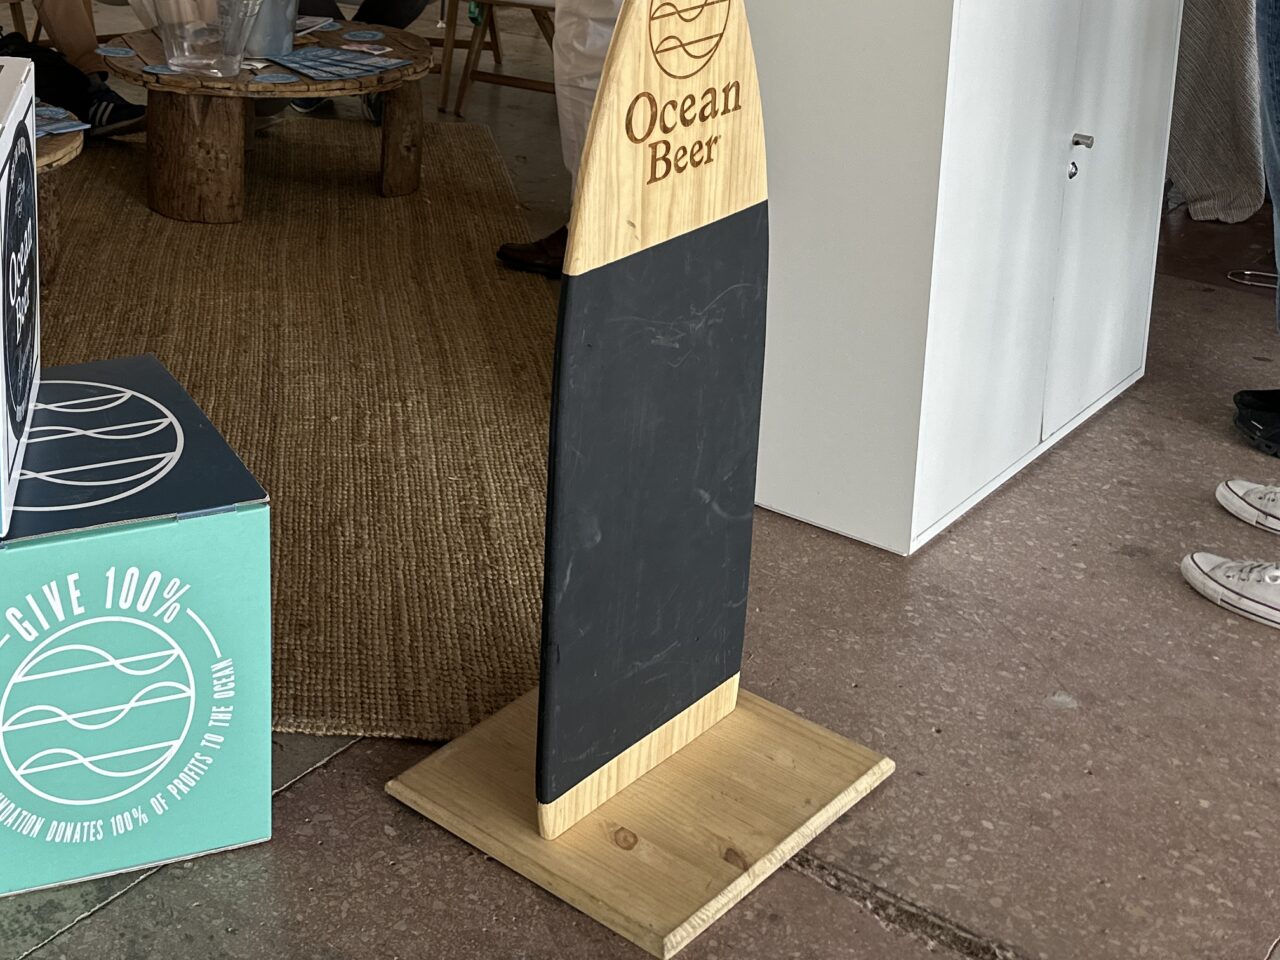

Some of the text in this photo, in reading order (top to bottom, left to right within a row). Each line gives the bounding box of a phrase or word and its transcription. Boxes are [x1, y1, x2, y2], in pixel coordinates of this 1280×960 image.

[625, 80, 743, 145] Ocean
[646, 134, 721, 185] Beer
[9, 217, 32, 307] Ocean
[5, 566, 191, 642] GIVE 100%
[210, 658, 235, 699] OCEAN
[208, 705, 234, 727] THE
[200, 732, 225, 750] TO
[166, 751, 214, 800] PROFITS
[110, 805, 149, 836] 100%
[149, 792, 169, 815] OF
[45, 819, 104, 843] DONATES
